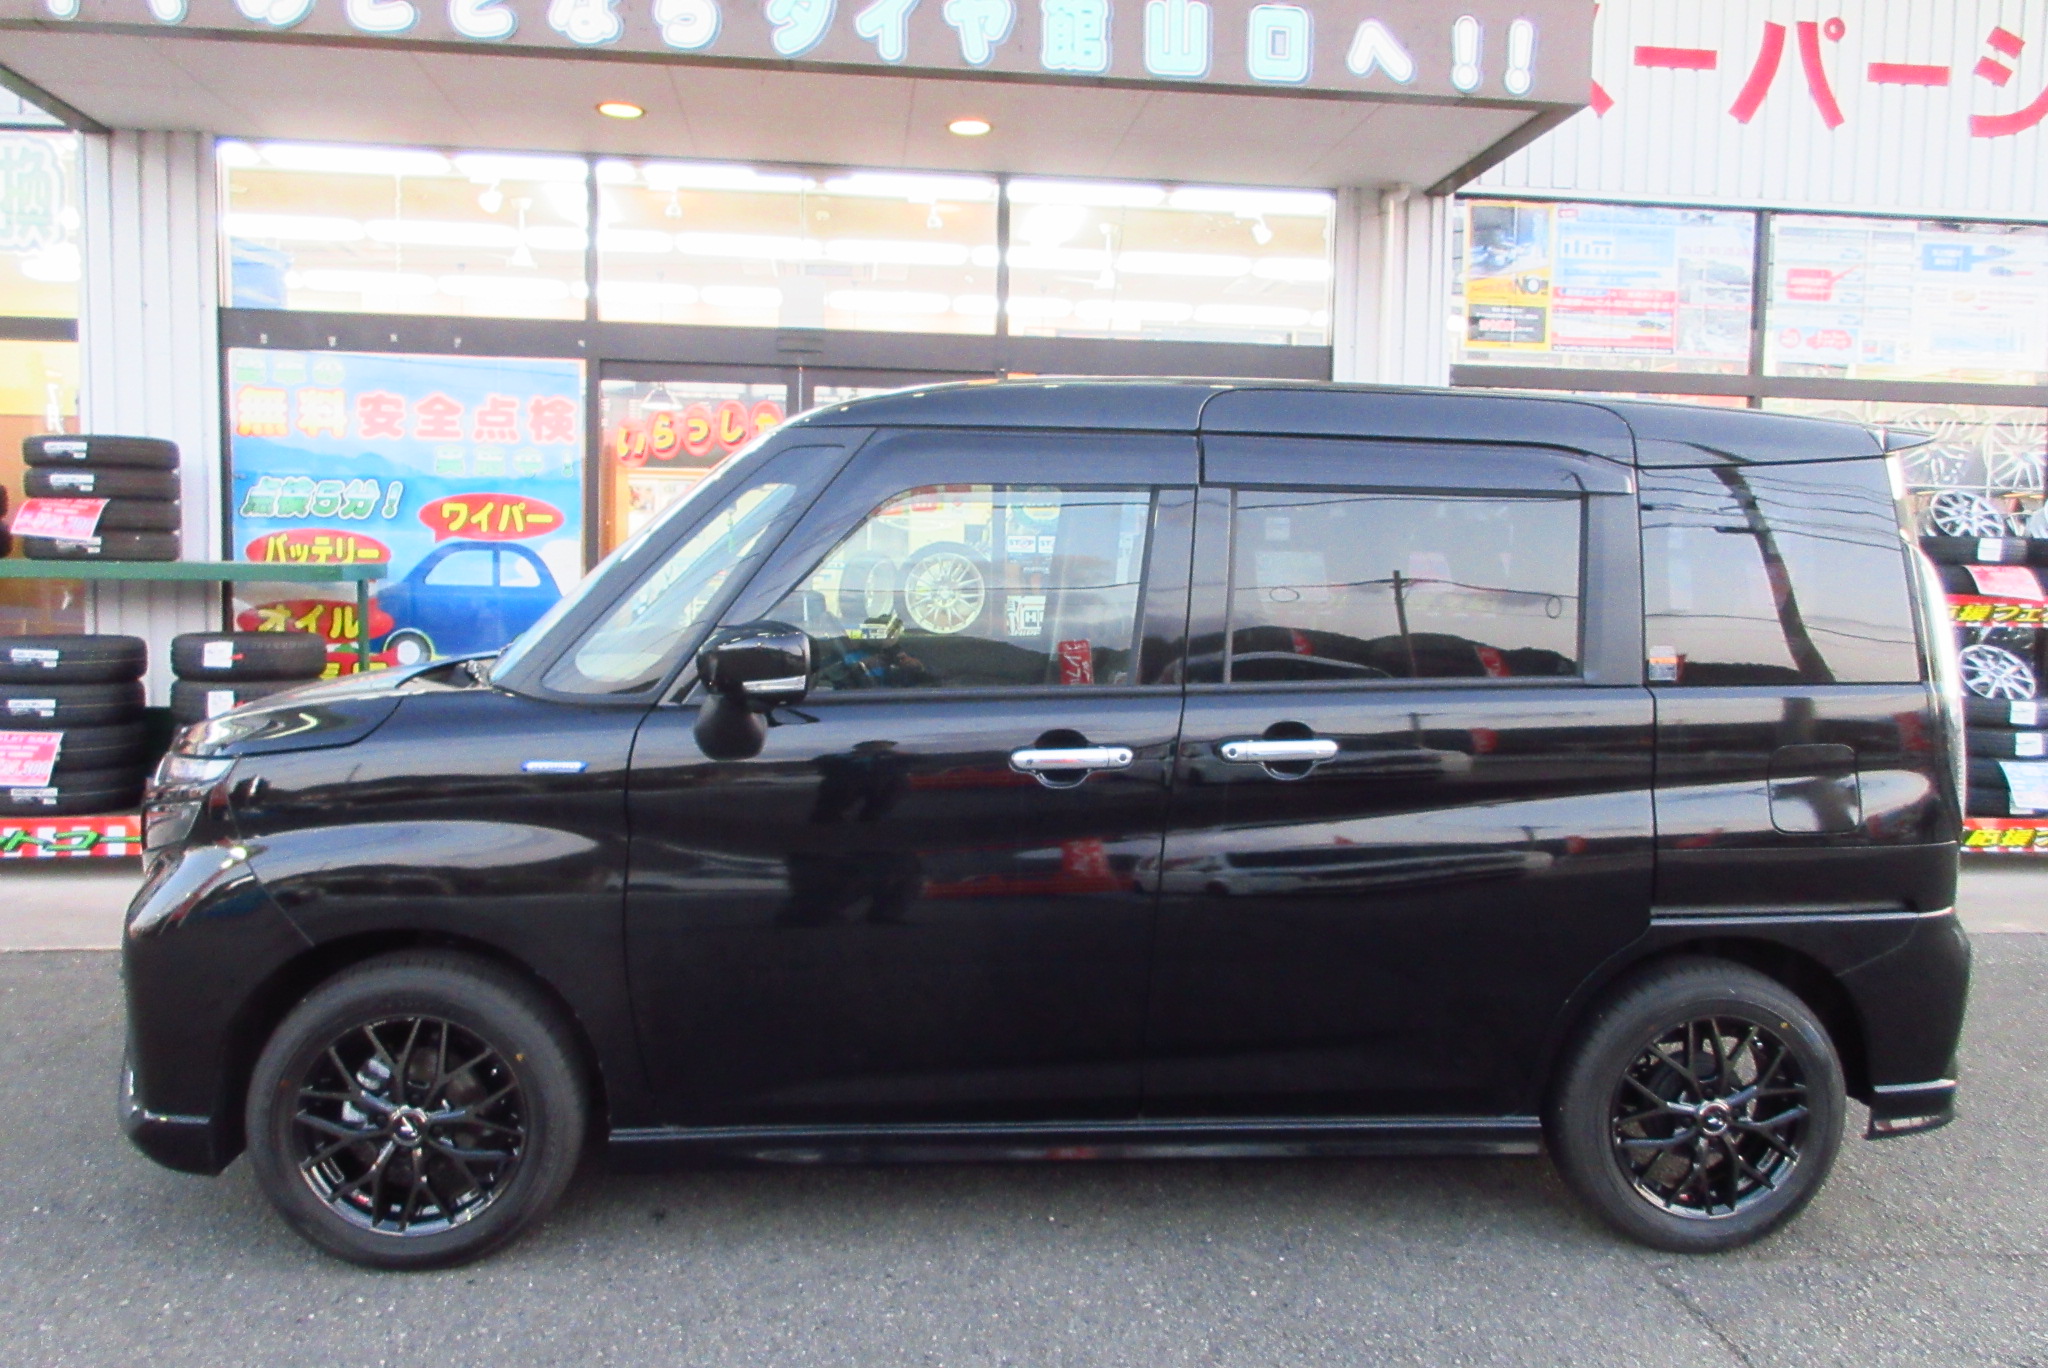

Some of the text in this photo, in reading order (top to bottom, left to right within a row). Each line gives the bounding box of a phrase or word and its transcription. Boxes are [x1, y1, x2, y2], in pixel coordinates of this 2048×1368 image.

[236, 386, 578, 443] 無料安全点検
[441, 502, 554, 532] ワイパー
[265, 535, 380, 562] バッテリー
[258, 604, 360, 639] オイル
